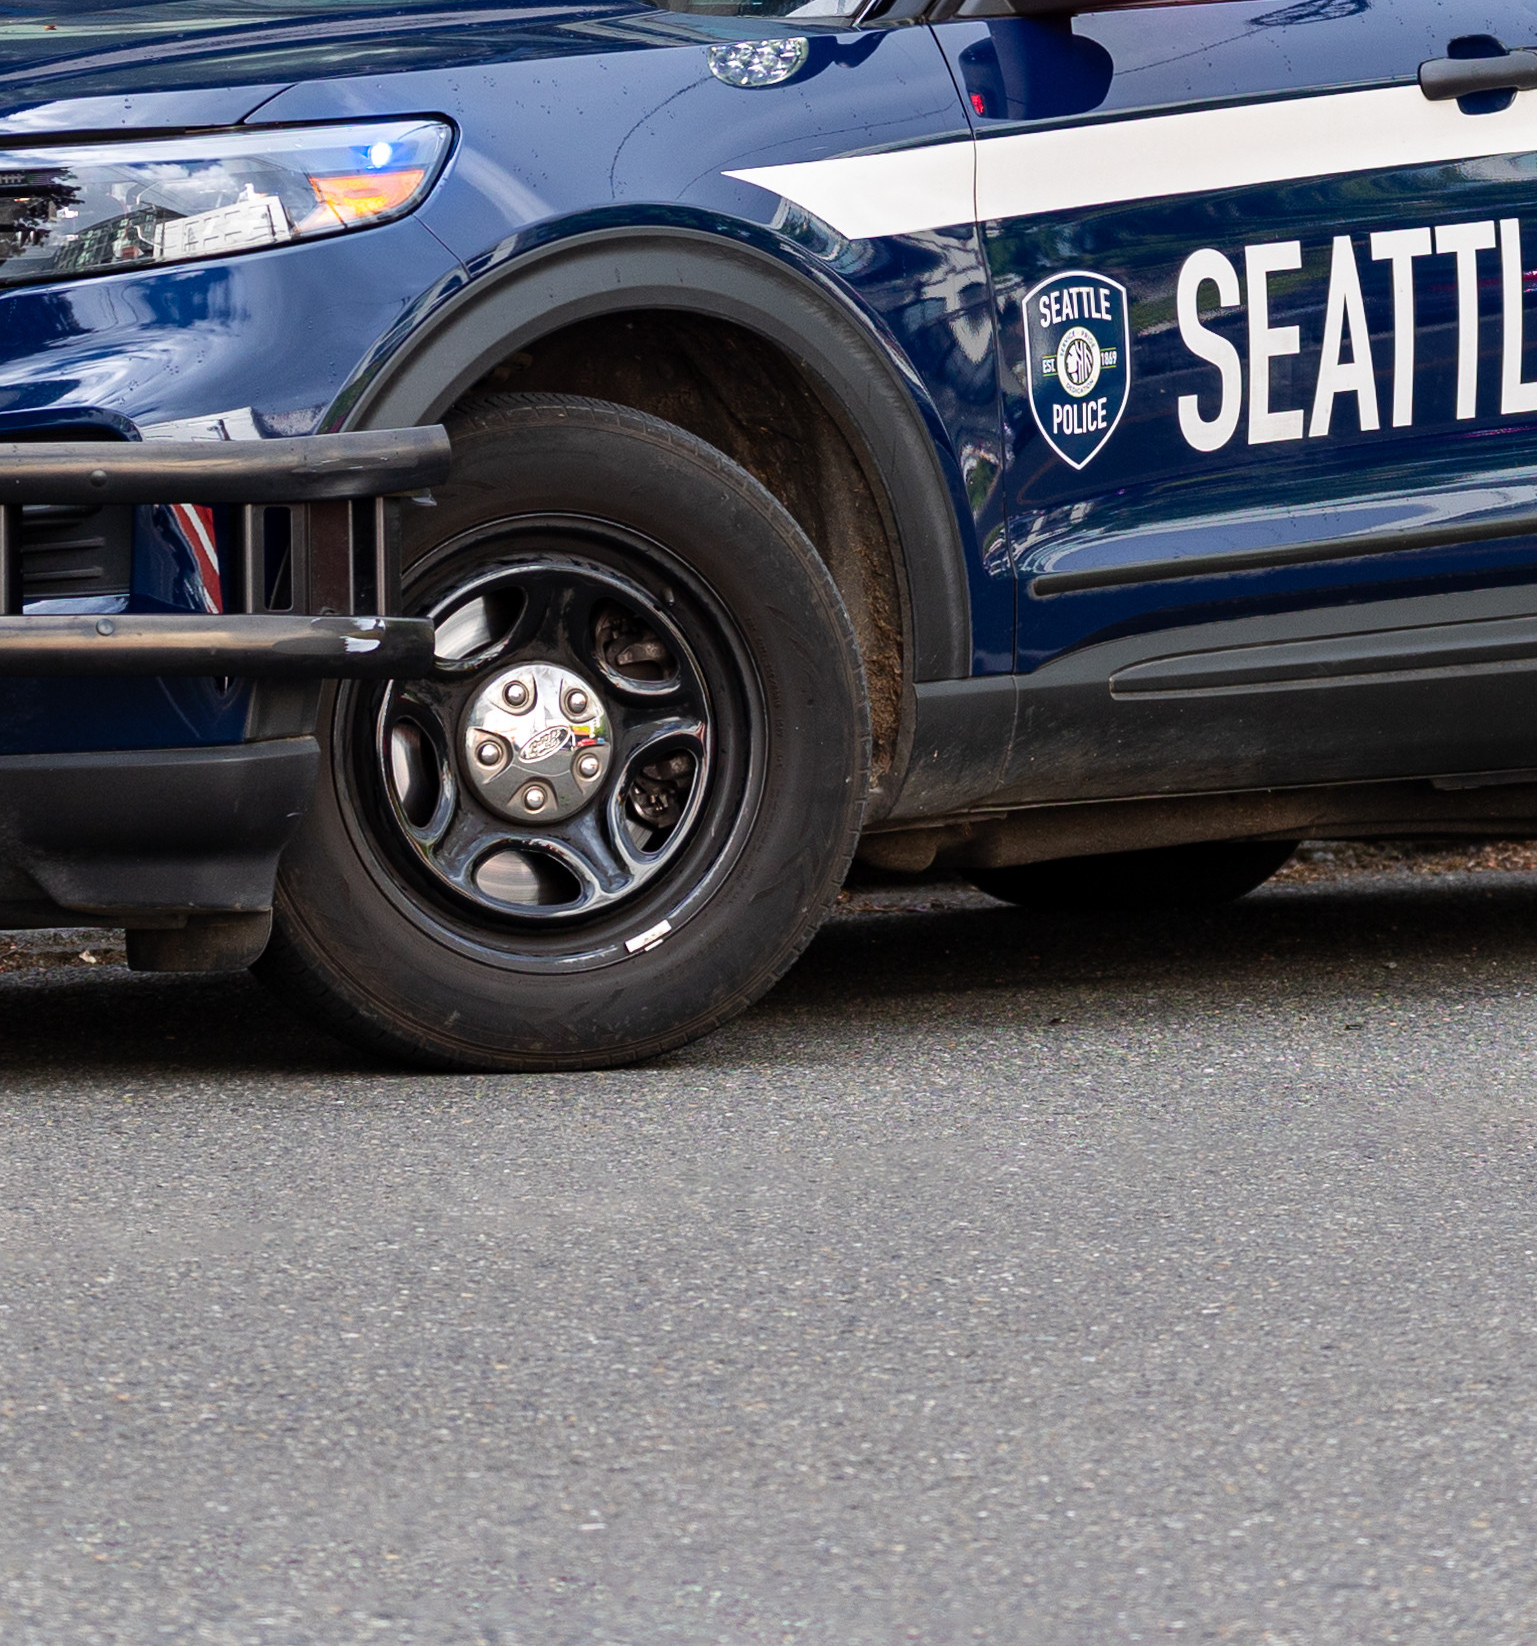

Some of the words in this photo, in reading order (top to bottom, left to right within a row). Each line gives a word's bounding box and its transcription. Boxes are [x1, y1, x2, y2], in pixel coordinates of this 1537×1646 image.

[1039, 286, 1112, 329] SEATTLE
[1100, 350, 1118, 366] 1869
[1053, 397, 1108, 435] POLICE
